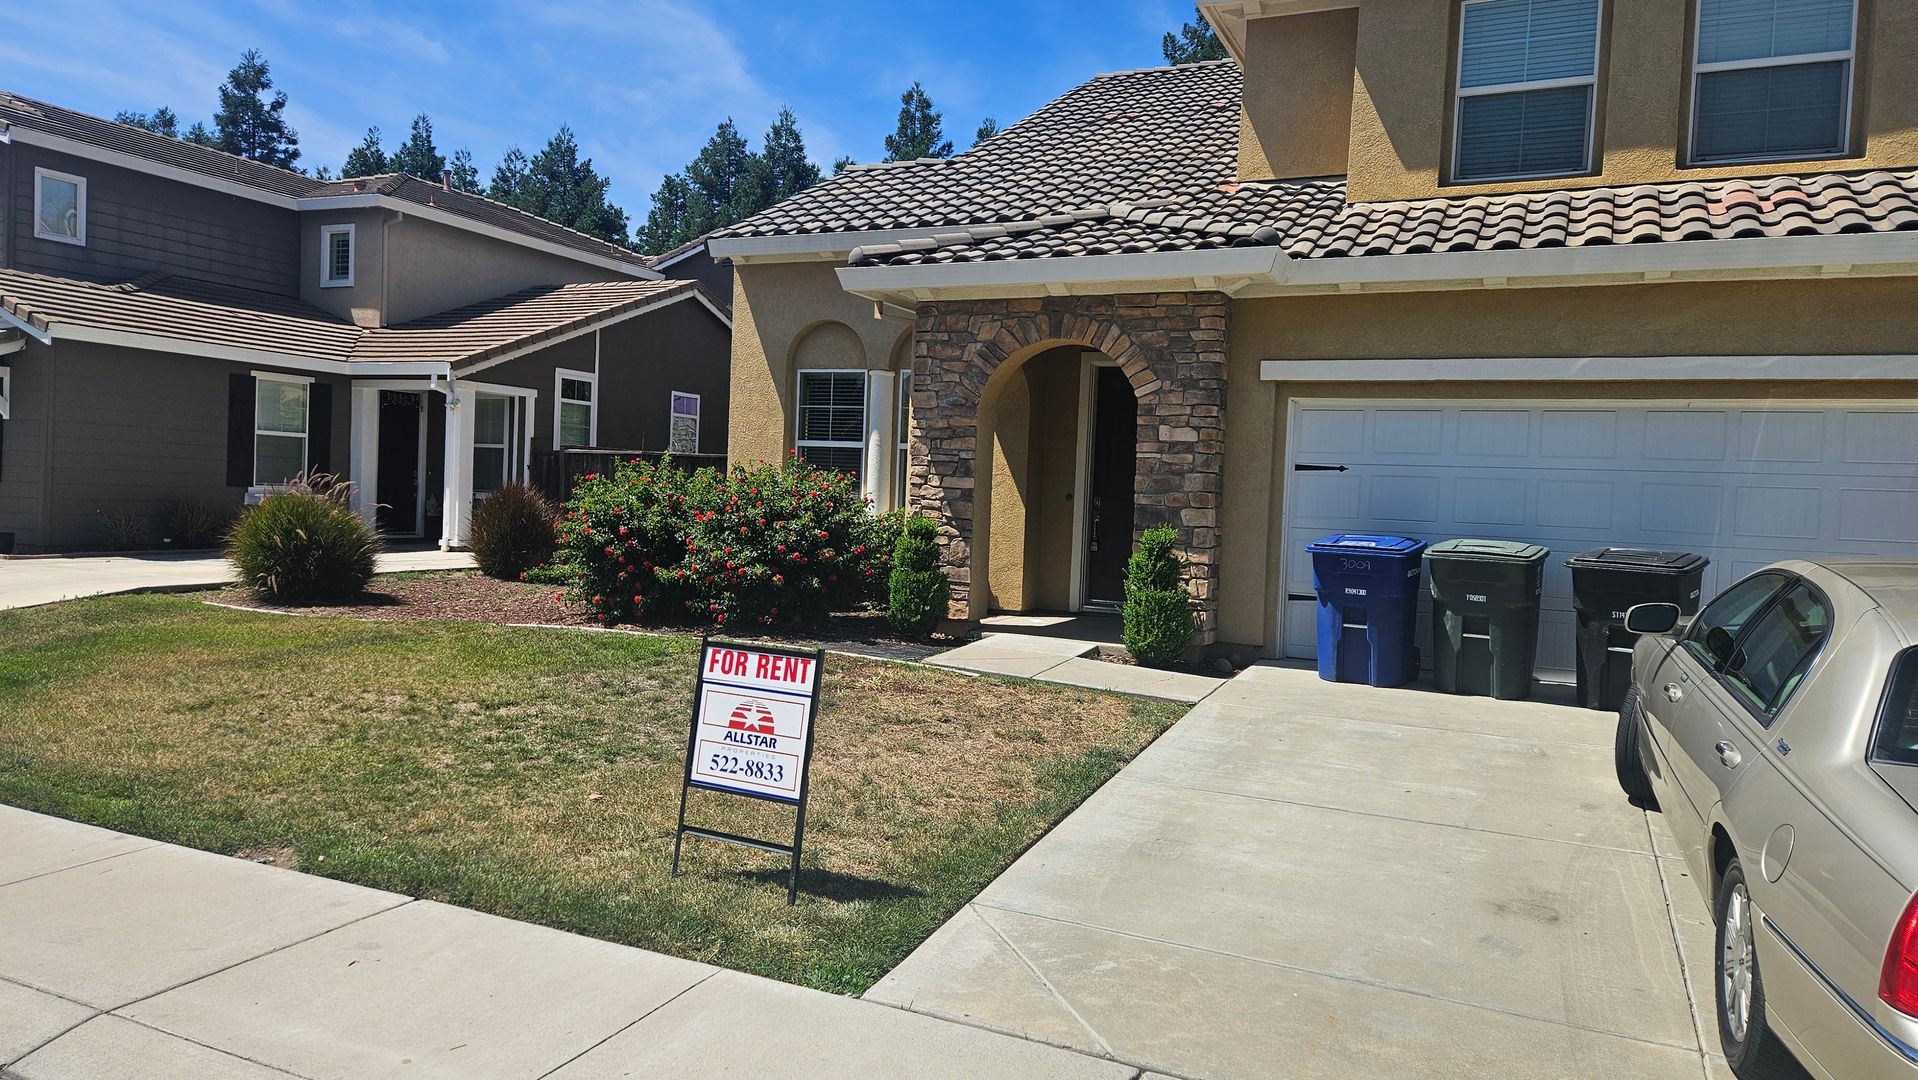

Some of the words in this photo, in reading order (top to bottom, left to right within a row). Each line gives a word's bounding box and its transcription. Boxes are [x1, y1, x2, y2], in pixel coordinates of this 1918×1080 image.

[1340, 558, 1371, 571] 3009
[708, 648, 749, 677] FOR
[755, 654, 812, 684] RENT
[723, 730, 778, 749] ALLSTAR
[721, 746, 776, 760] PROPERTIES
[709, 753, 784, 783] 522-8833
